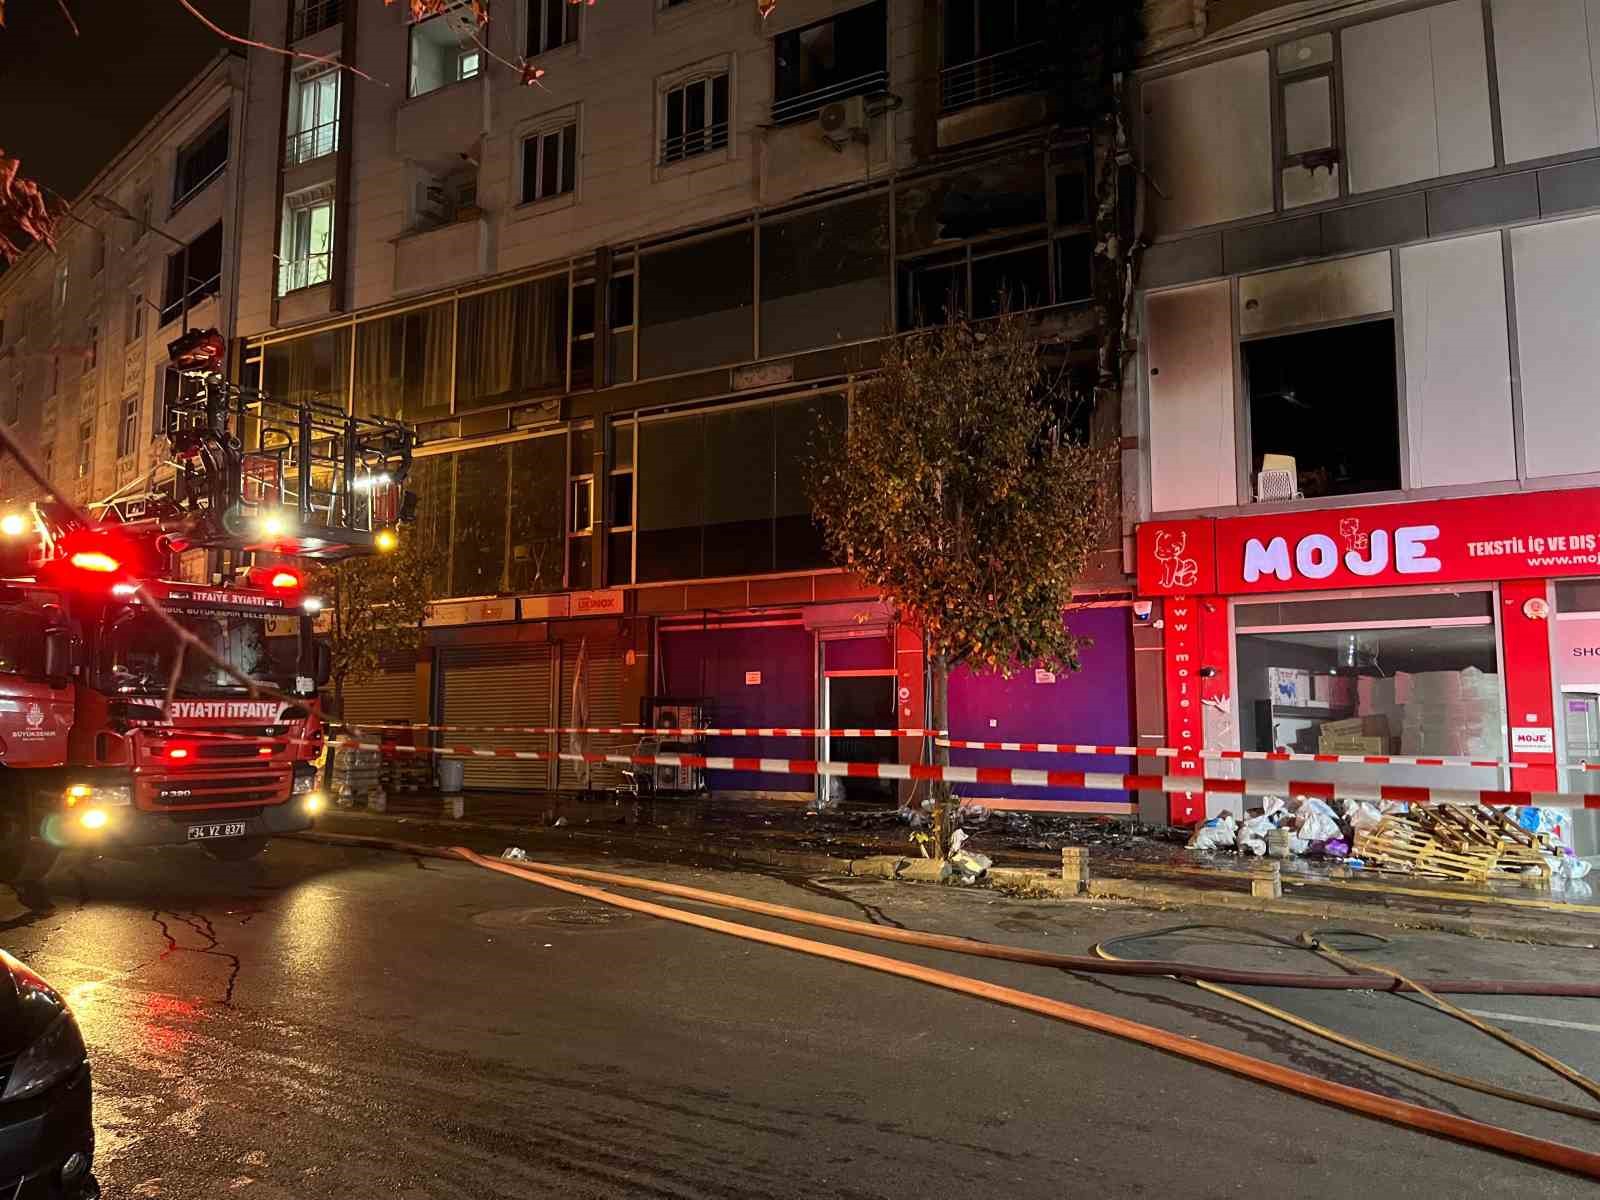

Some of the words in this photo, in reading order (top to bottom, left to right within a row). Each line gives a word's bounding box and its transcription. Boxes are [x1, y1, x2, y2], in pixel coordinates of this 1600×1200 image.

[1243, 524, 1442, 583] MOJE
[1467, 536, 1525, 557] TEKSTİL
[1528, 535, 1545, 555] İÇ
[1547, 536, 1567, 552] VE
[1517, 734, 1546, 743] MOJE
[193, 827, 204, 838] 34
[209, 825, 220, 836] VZ
